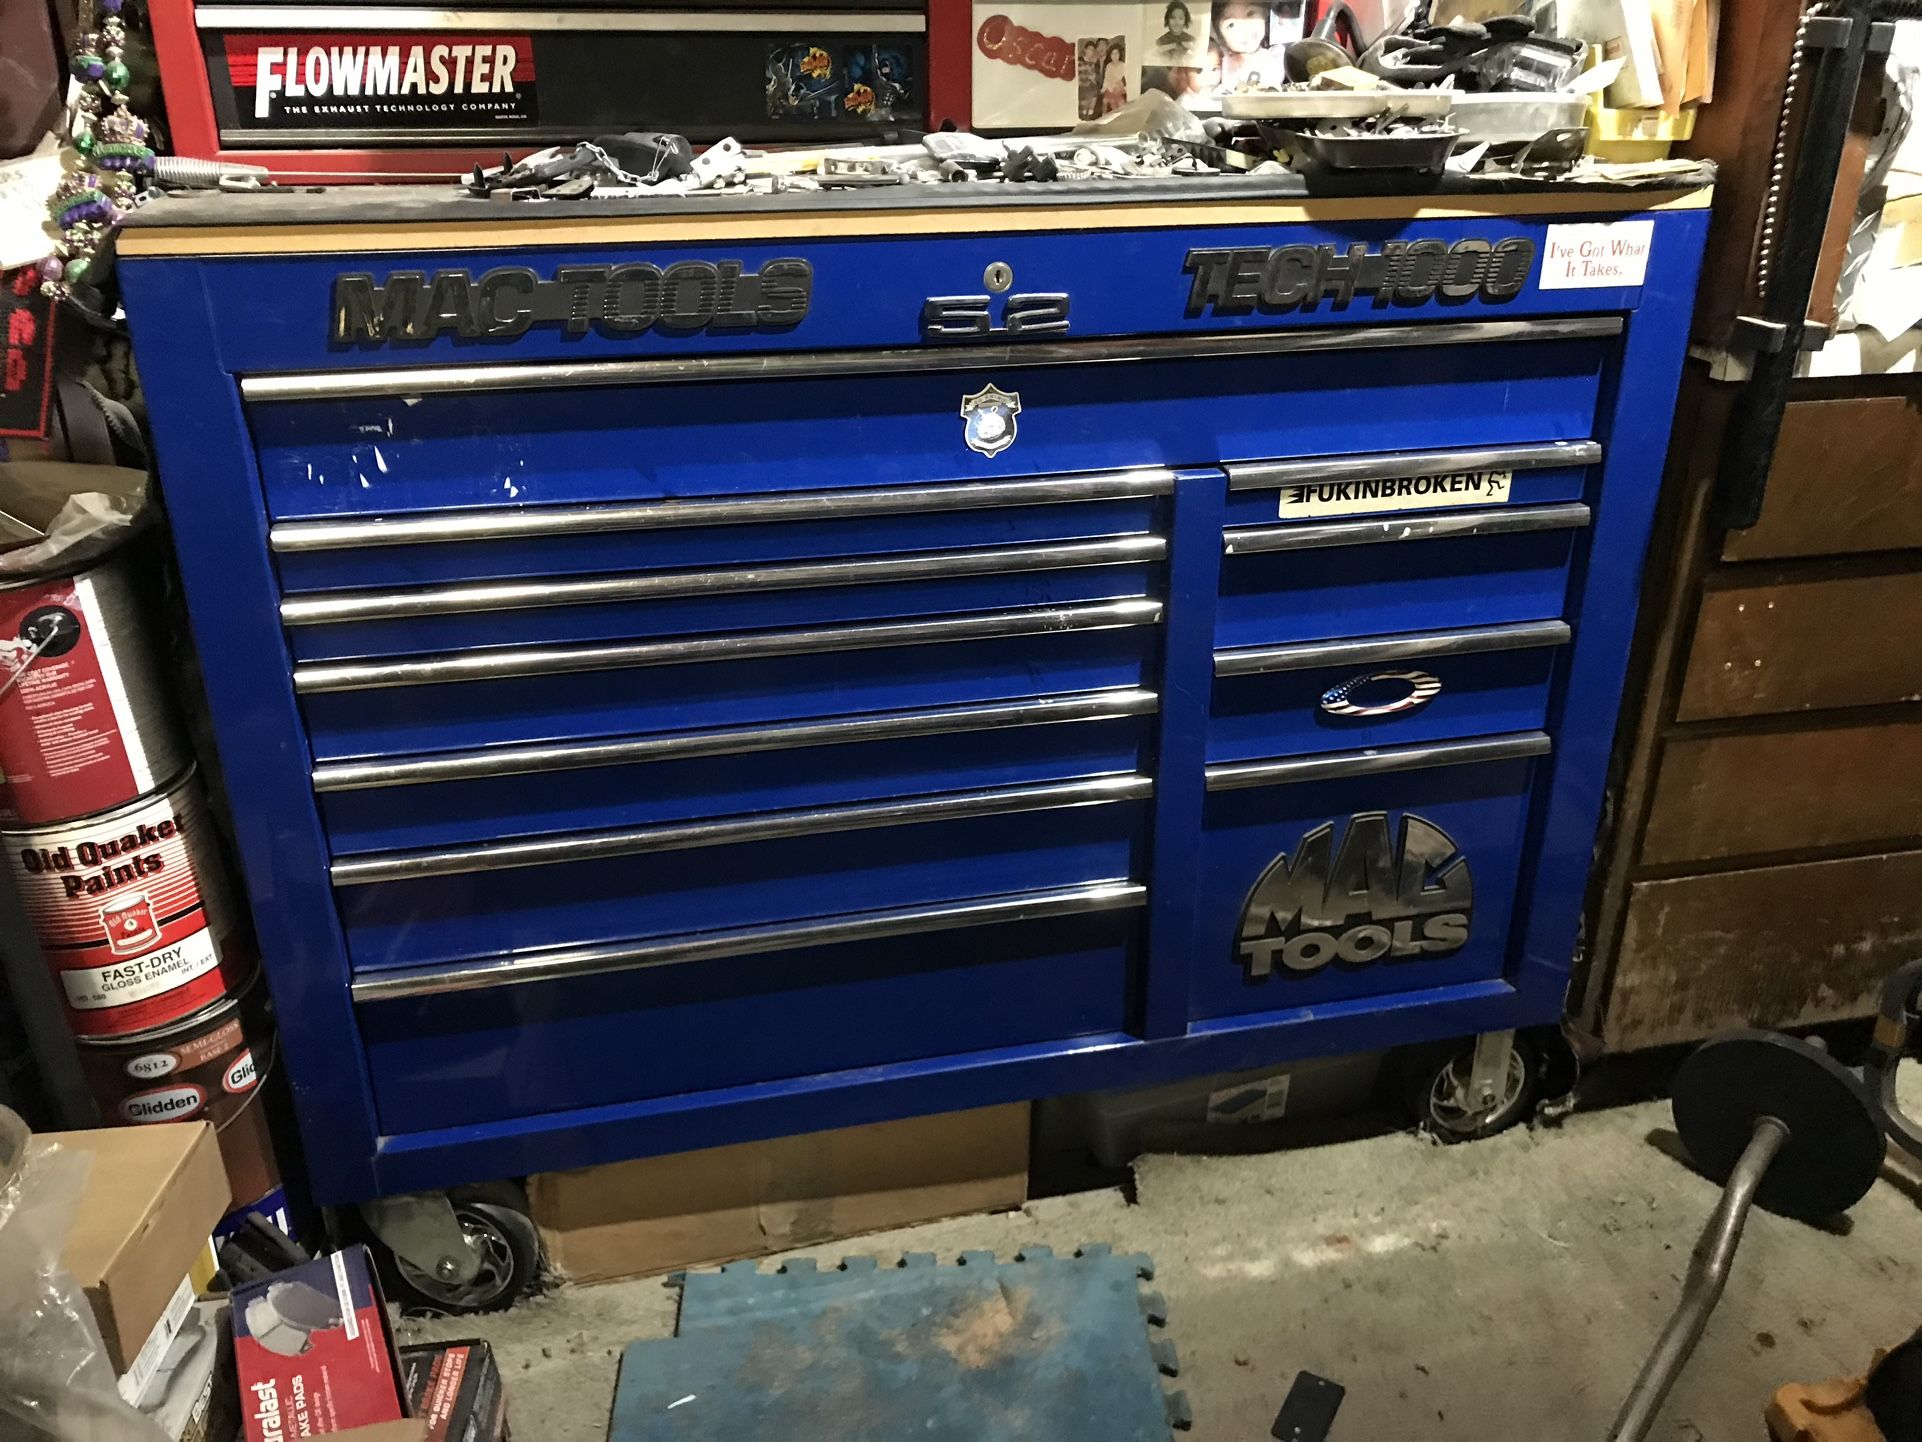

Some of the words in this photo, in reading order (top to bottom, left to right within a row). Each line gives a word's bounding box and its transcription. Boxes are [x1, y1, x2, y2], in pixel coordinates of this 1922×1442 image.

[255, 44, 516, 118] FLOWMASTER
[284, 105, 308, 114] THE
[313, 105, 370, 114] EXHAUST
[375, 104, 454, 113] TECHNOLOGY
[461, 102, 516, 111] COMPANY
[1550, 241, 1575, 259] I've
[1580, 240, 1605, 258] Got
[1610, 239, 1645, 257] What
[1565, 261, 1576, 278] It
[1303, 471, 1484, 503] FUKINBROKEN
[21, 846, 75, 874] Old
[76, 813, 185, 867] Quaker
[60, 853, 165, 899] Paints
[1237, 811, 1473, 938] MAC
[1239, 913, 1469, 977] TOOLS
[101, 946, 182, 983] FAST-DRY
[101, 975, 142, 992] GLOSS
[145, 958, 190, 981] ENAMEL
[181, 964, 194, 975] INT
[200, 953, 213, 966] EXT
[133, 1060, 169, 1074] 6812
[128, 1094, 198, 1117] Glidden
[292, 1374, 306, 1410] PADS
[432, 1378, 449, 1413] QUICKER
[445, 1370, 460, 1401] LONGER
[440, 1402, 451, 1420] AND
